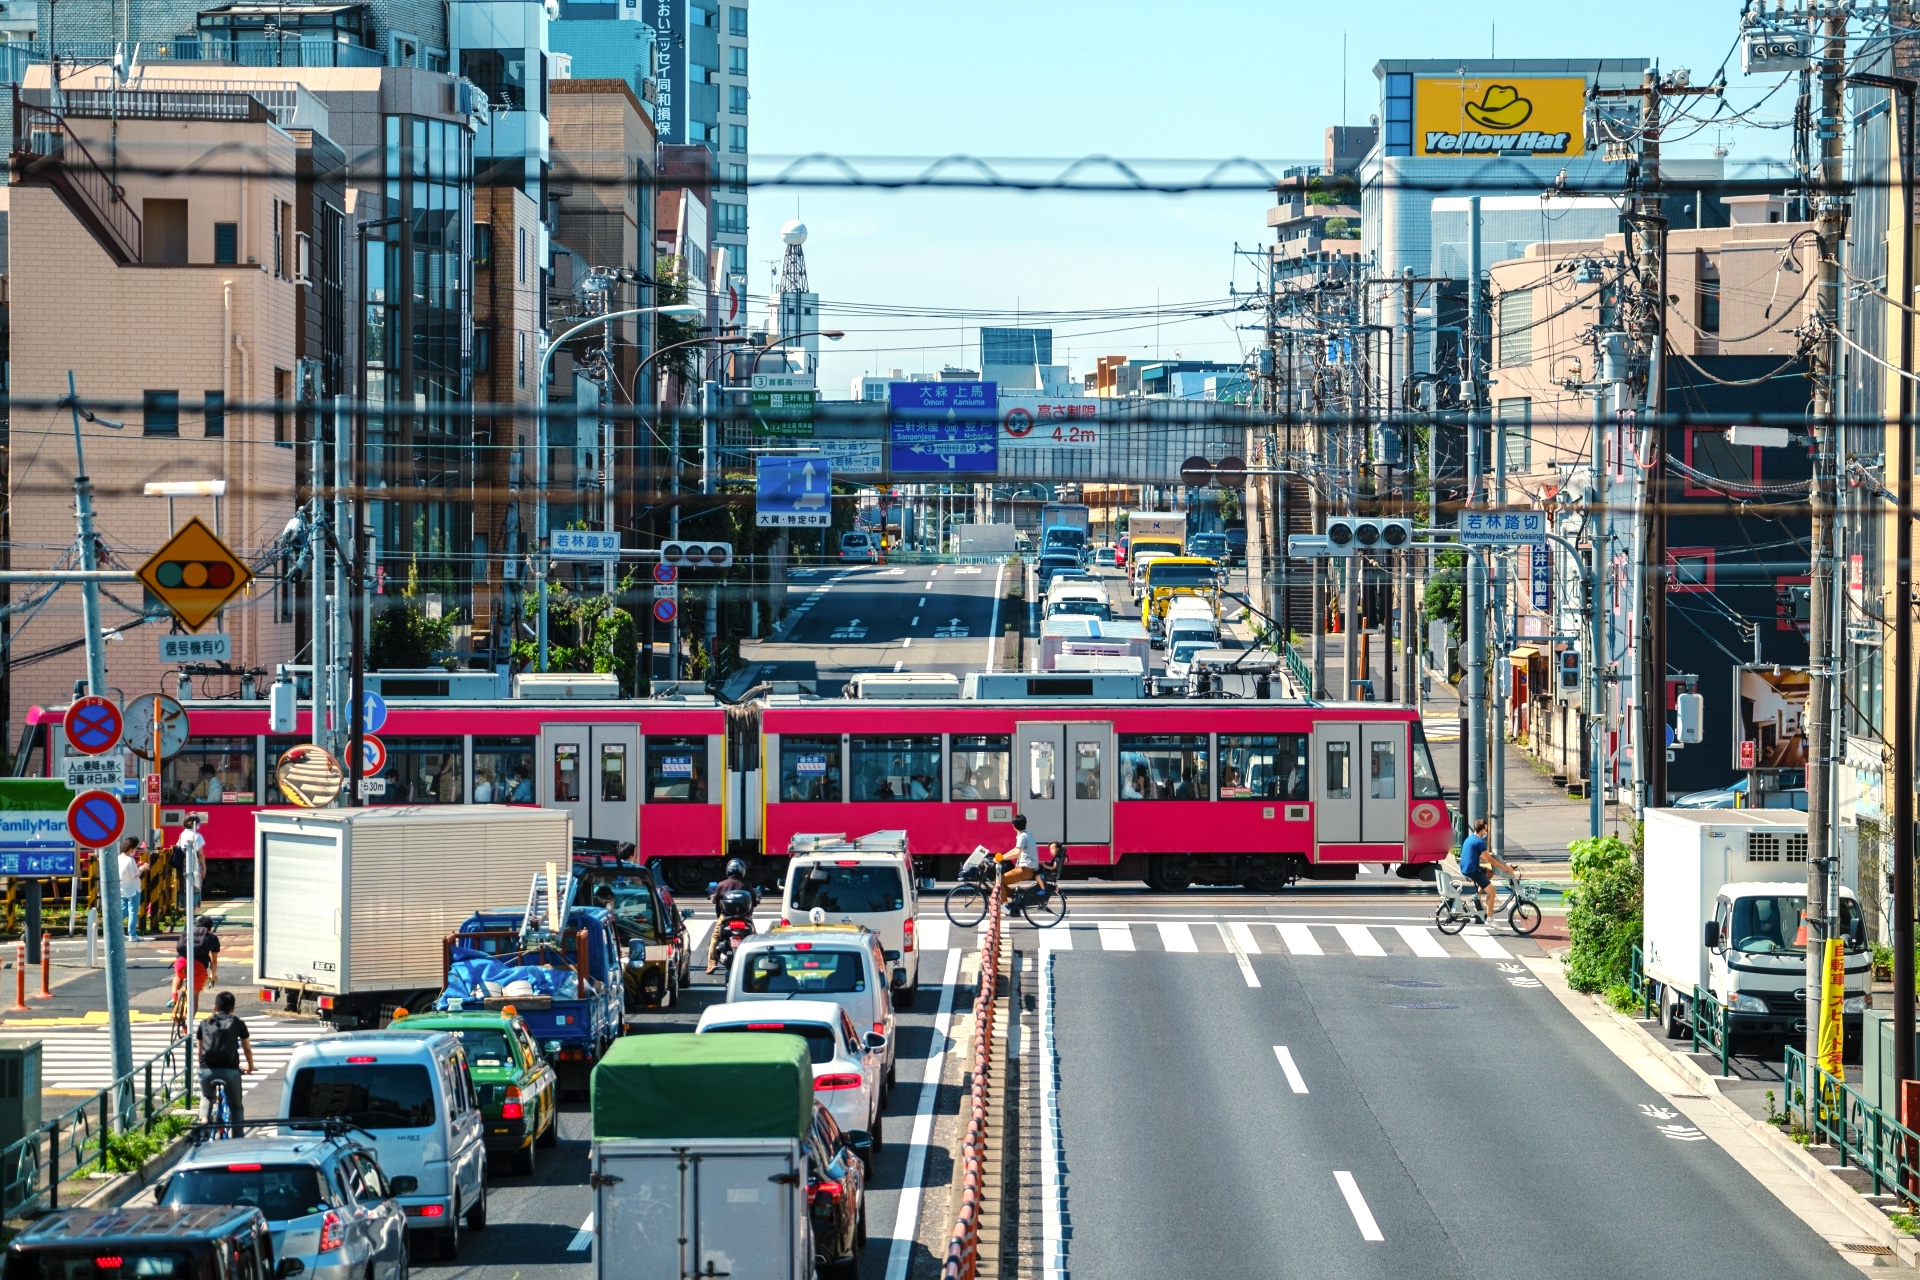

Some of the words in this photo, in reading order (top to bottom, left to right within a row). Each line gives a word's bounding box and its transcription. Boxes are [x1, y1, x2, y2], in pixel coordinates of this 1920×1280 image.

[784, 393, 810, 402] 三軒茶屋
[920, 385, 948, 398] 大森
[955, 385, 983, 398] 上馬
[923, 398, 944, 406] Omori
[953, 398, 985, 406] Kamiuma
[1037, 404, 1096, 420] 高さ制限
[893, 420, 939, 432] 三軒茶屋
[964, 420, 992, 432] 登戸
[896, 432, 936, 441] Sangenjaya
[1052, 426, 1095, 442] 4.2m
[1467, 514, 1539, 530] 若林踏切
[557, 534, 615, 549] 若林踏切
[1463, 531, 1511, 541] Wakabayashi
[1511, 531, 1543, 541] Crossing
[552, 547, 592, 556] Wakabayashi
[165, 640, 224, 656] 信号機有り
[68, 760, 122, 773] 人の乗降を除く
[0, 853, 20, 873] 酒
[27, 855, 67, 872] たばこ
